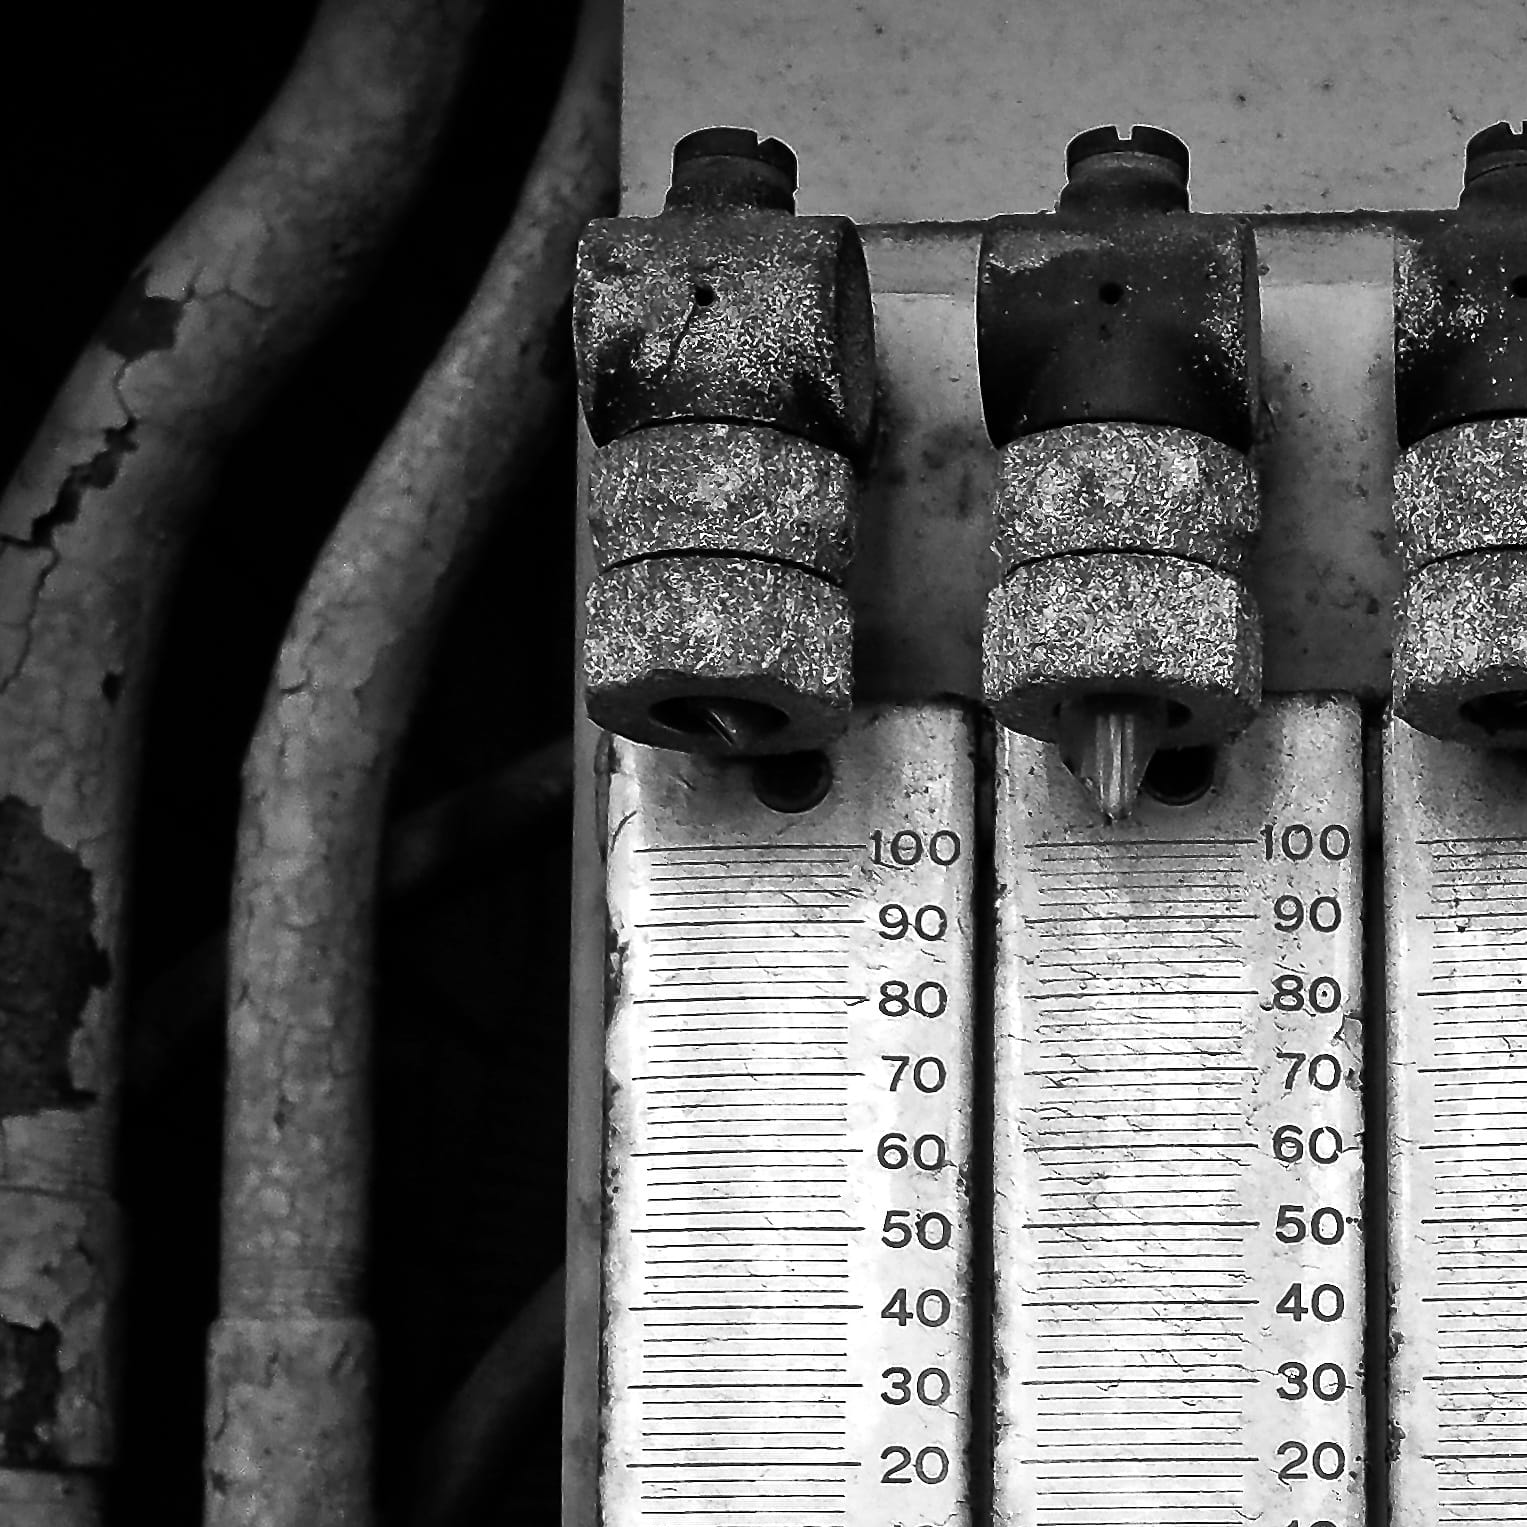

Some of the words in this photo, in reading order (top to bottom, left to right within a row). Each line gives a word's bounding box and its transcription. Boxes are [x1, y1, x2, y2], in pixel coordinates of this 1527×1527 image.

[868, 830, 960, 867] 100
[1260, 825, 1349, 862] 100
[878, 904, 947, 941] 90
[1274, 895, 1341, 933] 90
[880, 979, 947, 1017] 80
[1275, 972, 1342, 1010] 80
[881, 1055, 946, 1093] 70
[1275, 1049, 1342, 1087] 70
[878, 1133, 946, 1171] 60
[1275, 1127, 1342, 1165] 60
[880, 1211, 948, 1249] 50
[1275, 1205, 1342, 1243] 50
[881, 1288, 950, 1327] 40
[1276, 1283, 1344, 1322] 40
[881, 1367, 949, 1406] 30
[1275, 1362, 1343, 1400] 30
[880, 1446, 949, 1484] 20
[1275, 1441, 1343, 1480] 20
